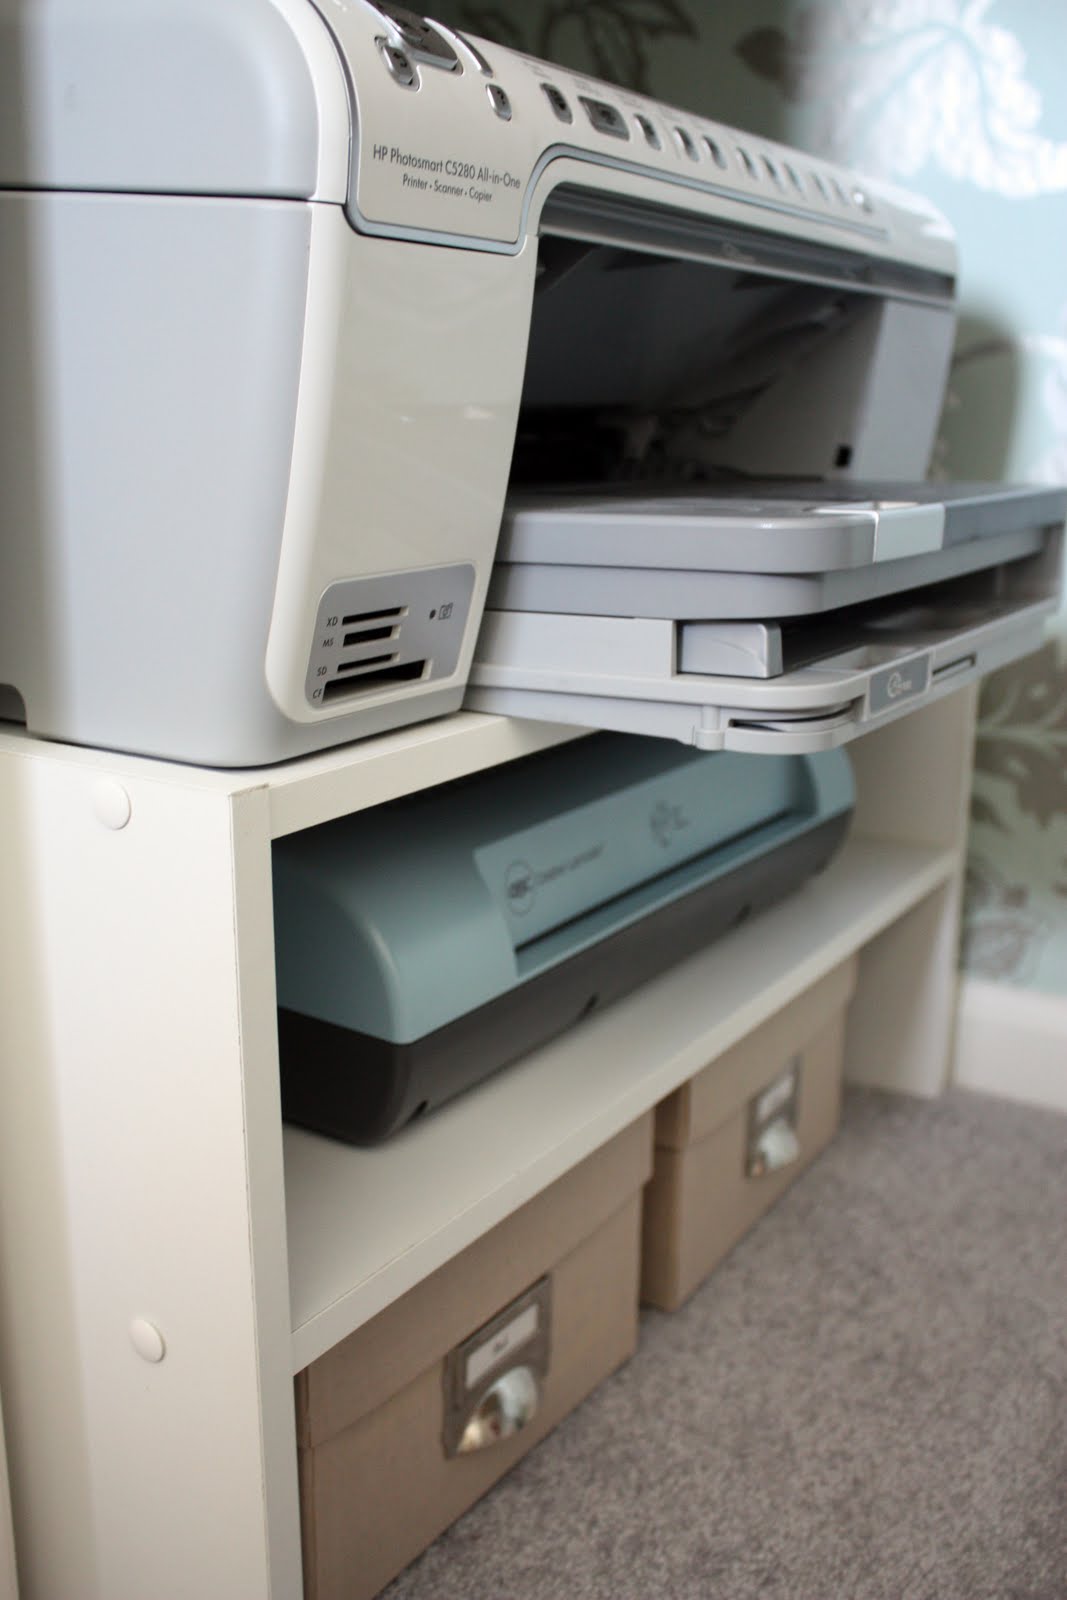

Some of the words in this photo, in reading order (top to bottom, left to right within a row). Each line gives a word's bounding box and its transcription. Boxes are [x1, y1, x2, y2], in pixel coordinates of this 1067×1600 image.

[373, 144, 388, 161] HP
[390, 147, 443, 173] Photosmart
[445, 159, 476, 180] C5280
[476, 167, 521, 189] All-in-One
[402, 173, 428, 191] Printer
[434, 180, 463, 197] Scanner
[469, 187, 493, 203] Copier
[326, 616, 338, 627] XD
[322, 639, 334, 647] MS
[316, 666, 327, 677] SD
[312, 688, 322, 699] CF
